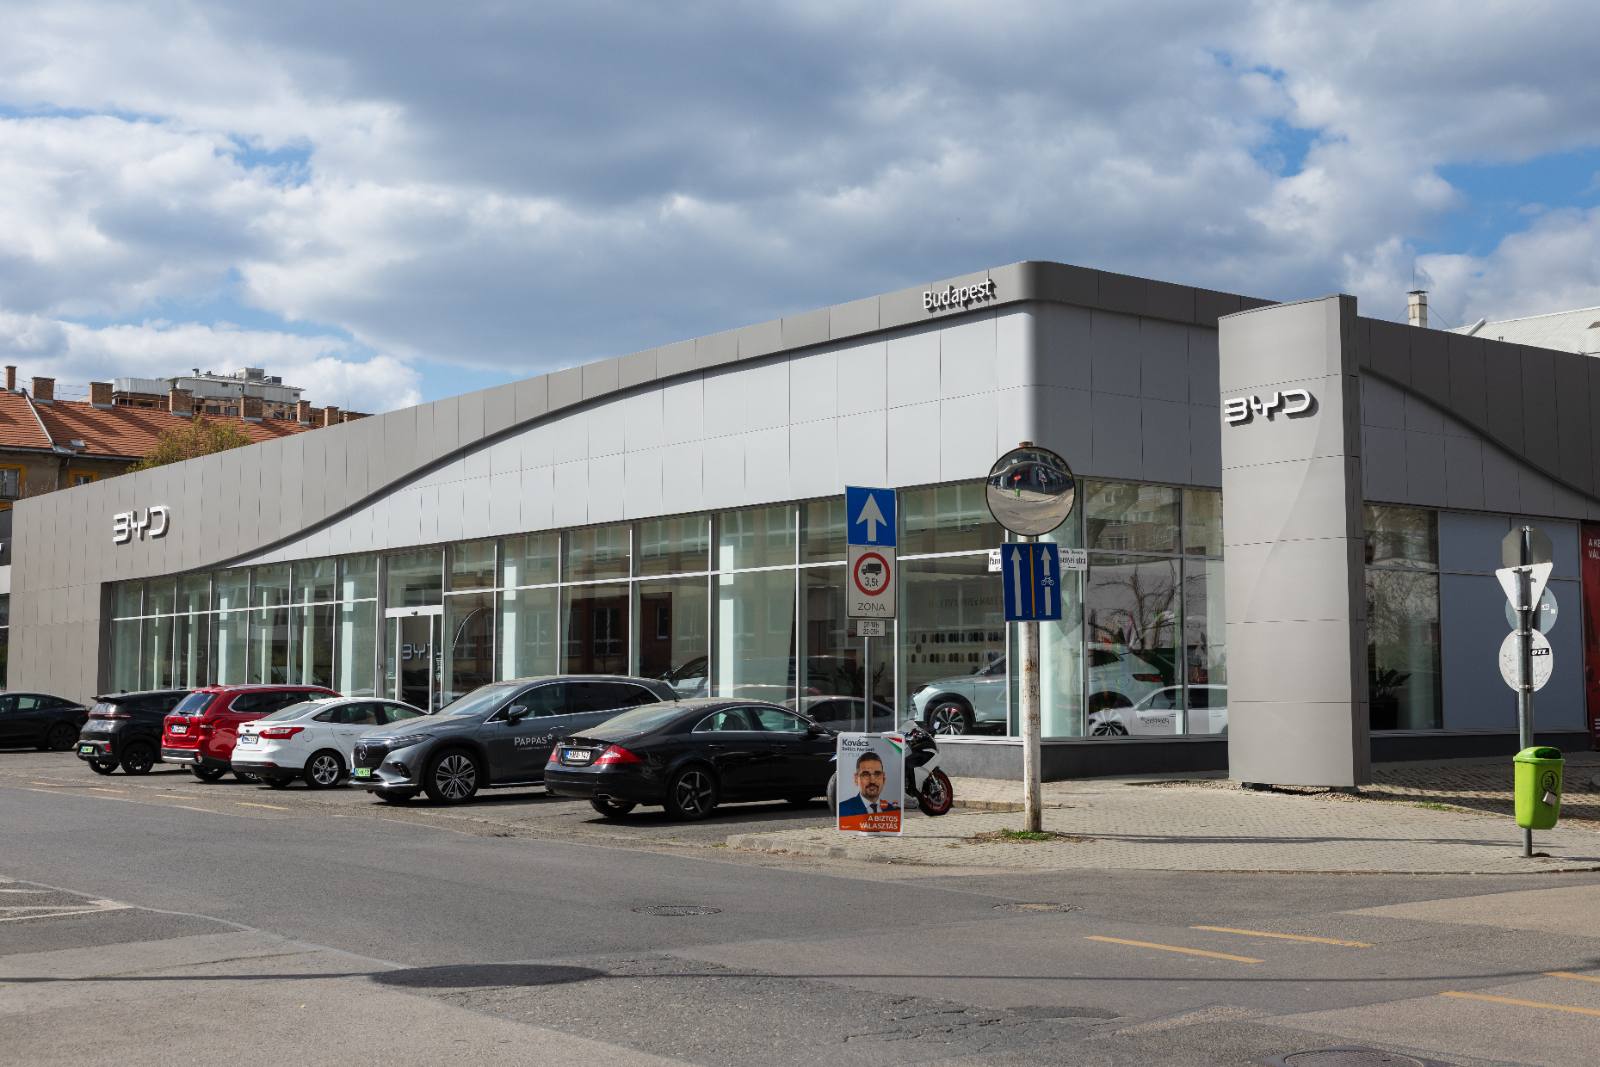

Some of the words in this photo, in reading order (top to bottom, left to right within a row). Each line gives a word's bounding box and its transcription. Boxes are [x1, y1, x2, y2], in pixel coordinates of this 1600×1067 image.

[923, 279, 992, 309] Budapest
[1224, 389, 1310, 423] BYD
[113, 505, 169, 543] BYD
[865, 577, 879, 587] 3,5t
[857, 602, 886, 611] ZONA
[514, 736, 548, 746] PAPPAS
[842, 738, 869, 747] Kovács
[859, 822, 898, 830] VÁLASZTÁS
